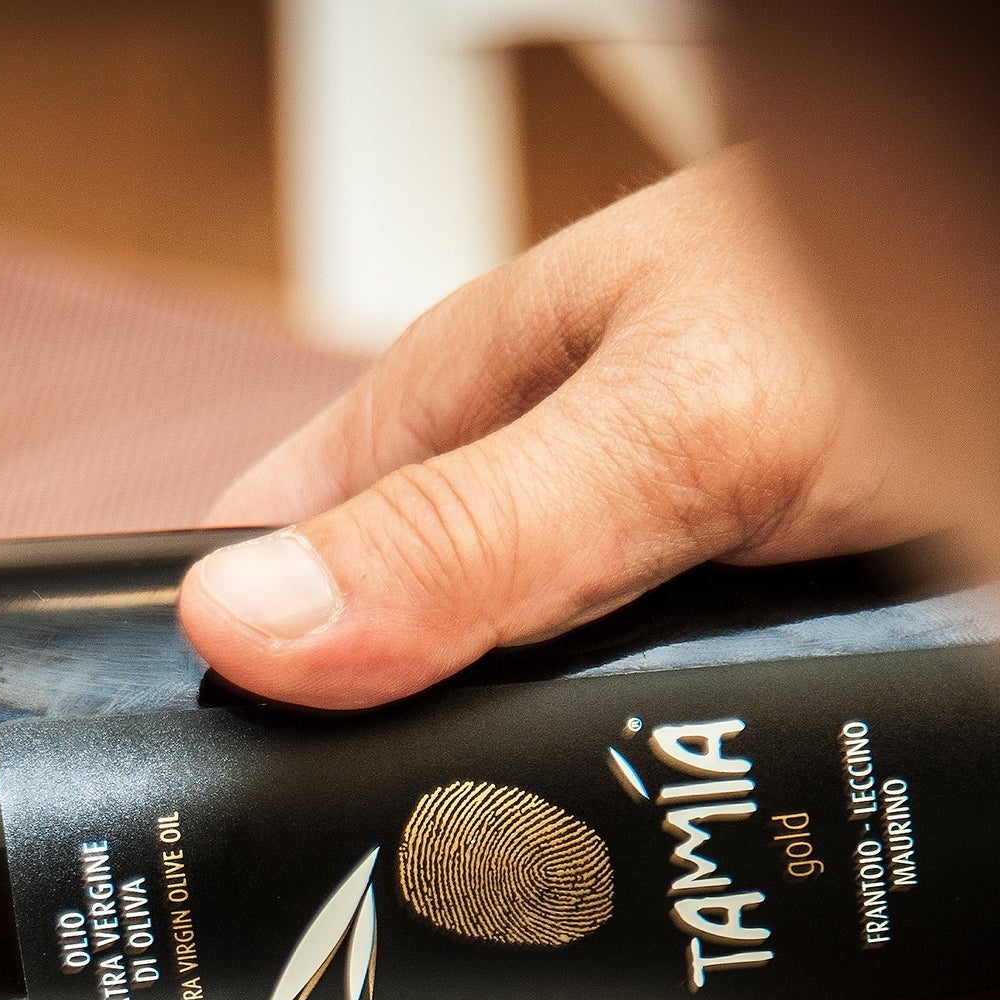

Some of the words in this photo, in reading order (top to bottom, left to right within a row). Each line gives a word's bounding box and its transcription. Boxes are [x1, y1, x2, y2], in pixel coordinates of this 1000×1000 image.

[843, 720, 878, 815] LECCINO
[158, 810, 182, 843] OIL
[771, 812, 825, 877] gold
[883, 778, 918, 886] MAURINO
[83, 840, 121, 947] VERGINE
[163, 849, 189, 902] OLIVE
[857, 840, 890, 944] FRANTOIO
[60, 911, 92, 968] OLIO
[122, 877, 155, 948] OLIVA
[171, 909, 199, 973] VIRGIN
[133, 957, 160, 982] DI
